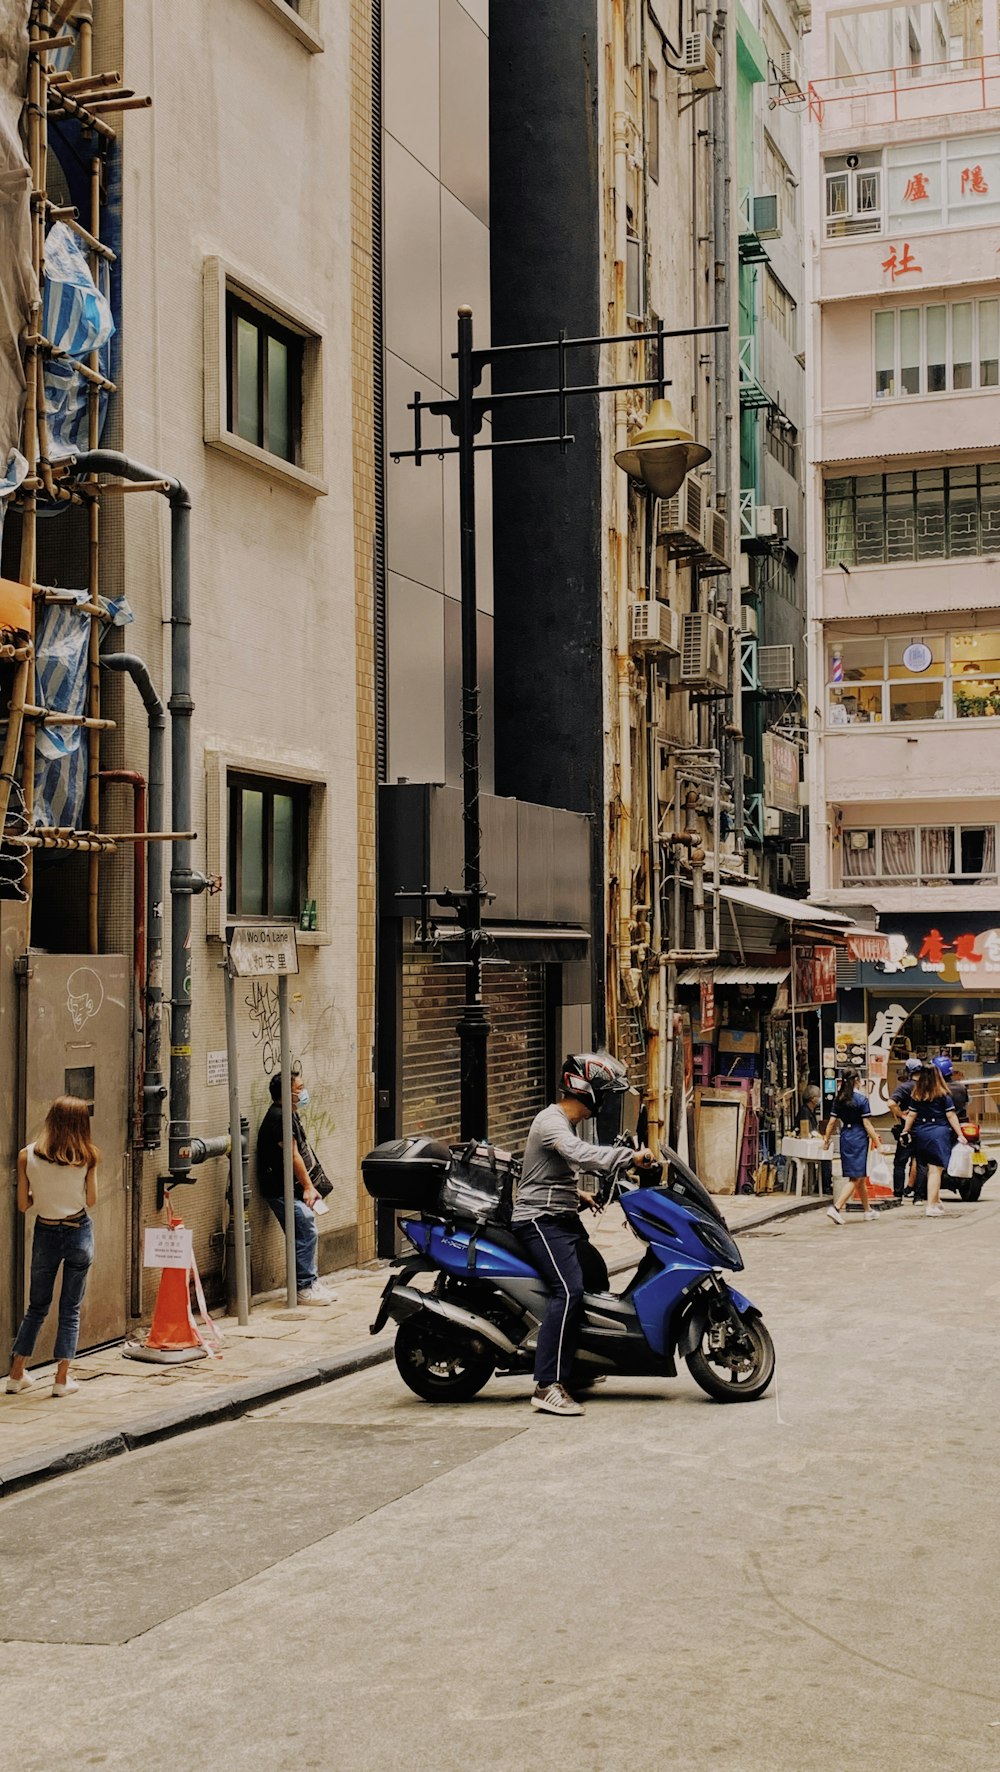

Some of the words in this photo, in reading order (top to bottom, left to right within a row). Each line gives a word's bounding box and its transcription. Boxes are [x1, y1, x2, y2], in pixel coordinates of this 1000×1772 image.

[961, 165, 988, 194] 隱
[881, 242, 923, 283] 社
[247, 931, 258, 943] Wo
[260, 931, 271, 943] On
[272, 932, 288, 943] Lane
[253, 953, 287, 971] 和安里
